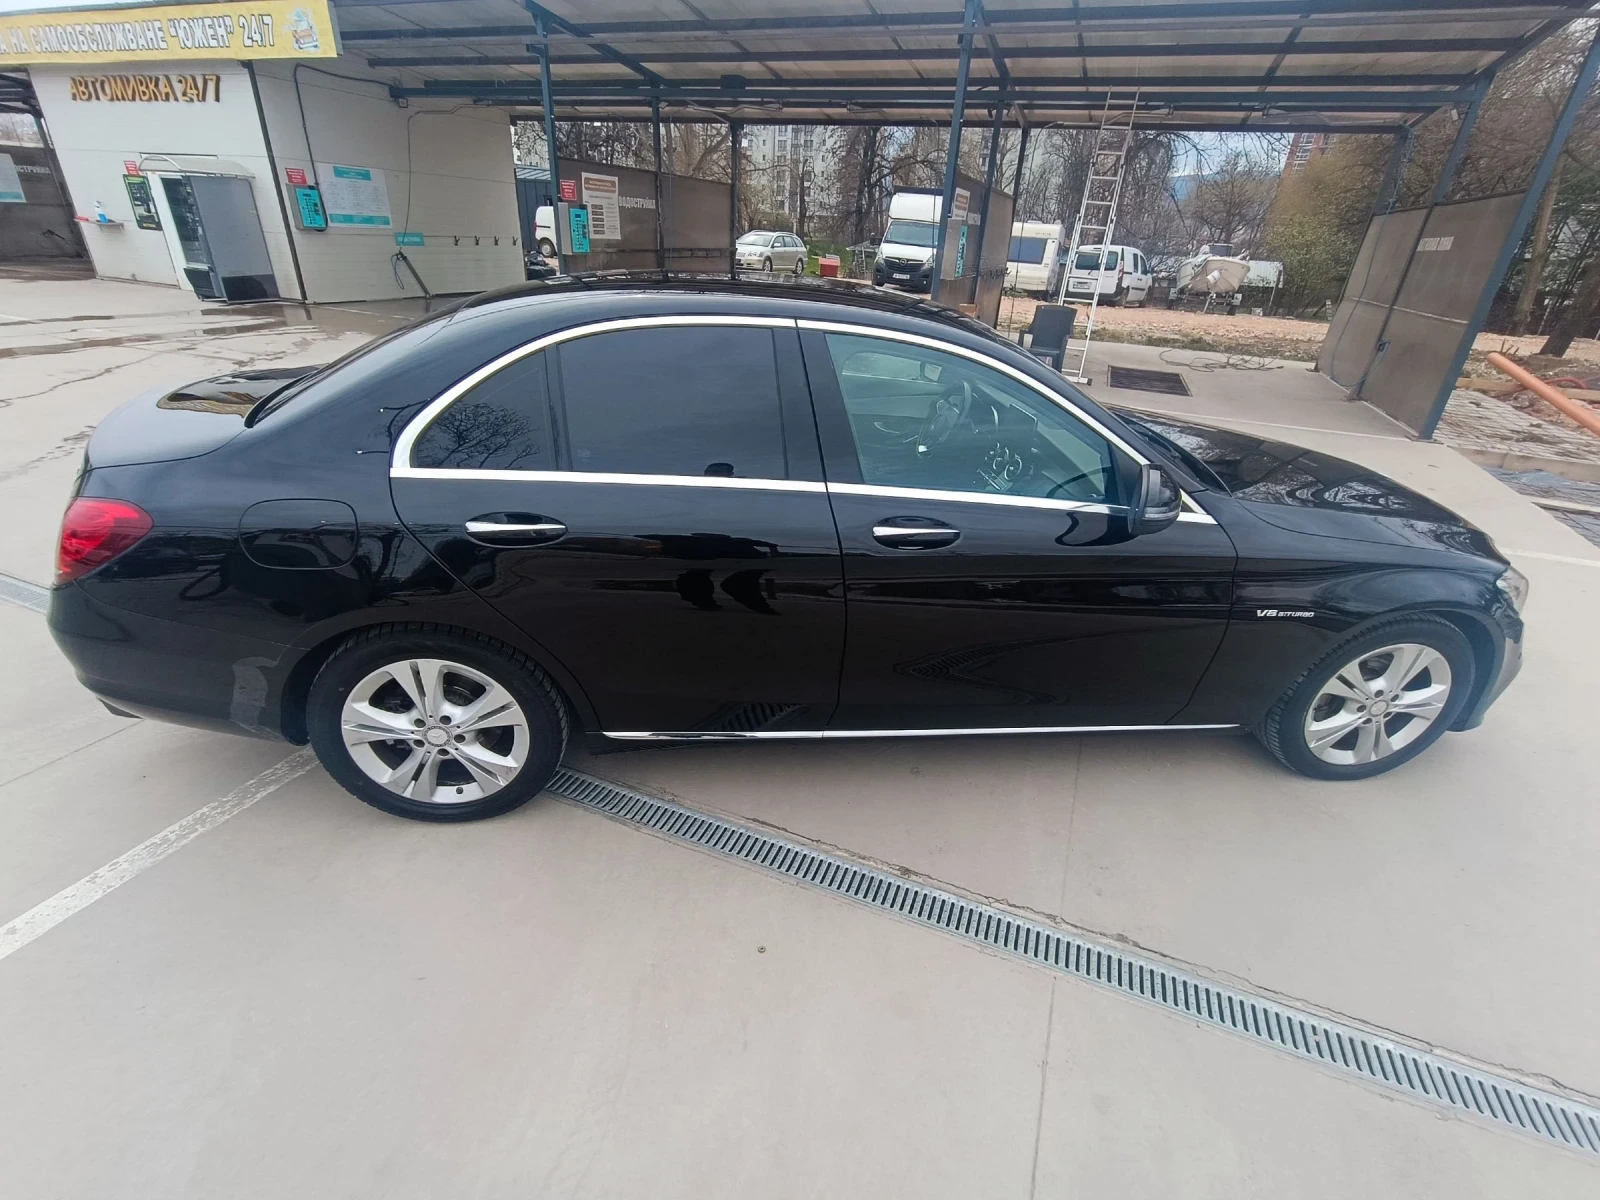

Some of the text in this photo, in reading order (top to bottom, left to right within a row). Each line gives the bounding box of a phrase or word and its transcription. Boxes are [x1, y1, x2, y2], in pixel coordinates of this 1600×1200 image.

[8, 26, 30, 54] НА
[29, 19, 168, 53] САМООБСЛУЖВАНЕ
[238, 14, 275, 47] 24/7
[70, 74, 221, 102] АВТОМИВКА 24/7
